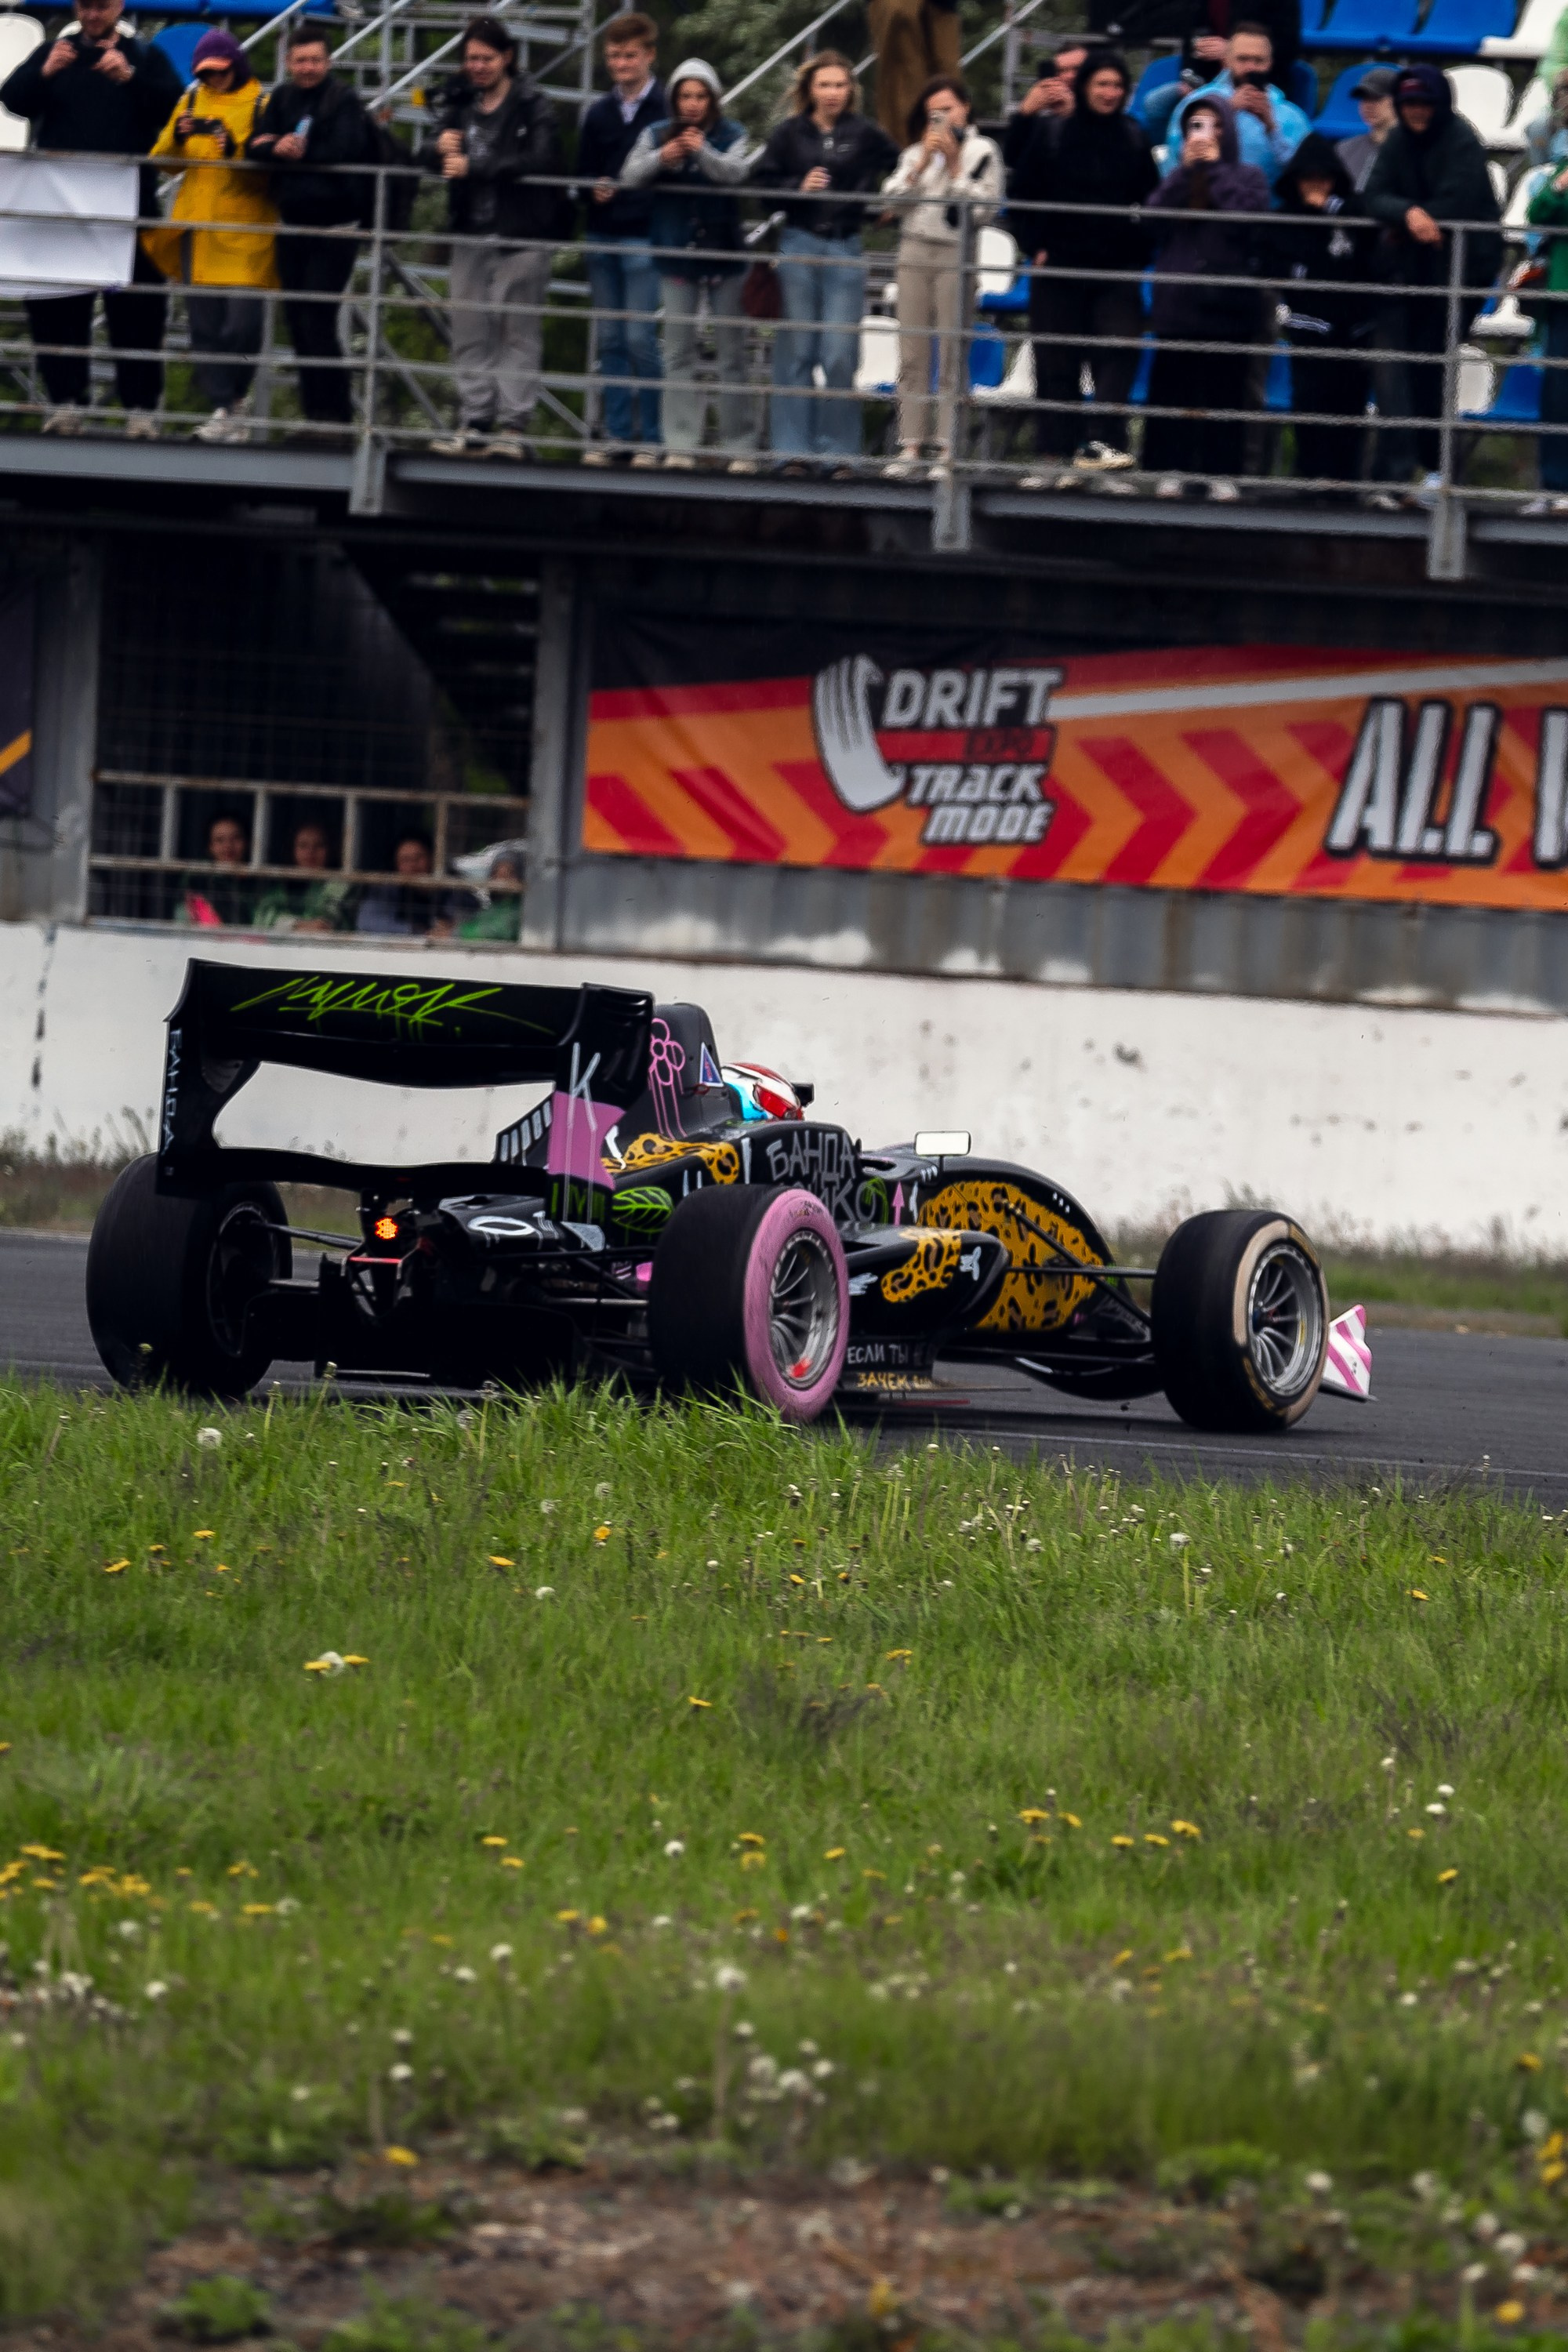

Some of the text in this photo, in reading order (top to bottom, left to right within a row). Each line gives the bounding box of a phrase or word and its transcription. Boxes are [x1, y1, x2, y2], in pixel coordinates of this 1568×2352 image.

[881, 666, 1065, 728] DRIFT
[906, 764, 1047, 805] TRACK
[1326, 699, 1495, 859] ALL
[924, 802, 1053, 844] MODE
[765, 1130, 857, 1189] БАНДА
[847, 1343, 885, 1364] ЕСЛИ
[888, 1342, 909, 1365] ТЫ
[856, 1370, 911, 1391] ЗАЧЕМ
